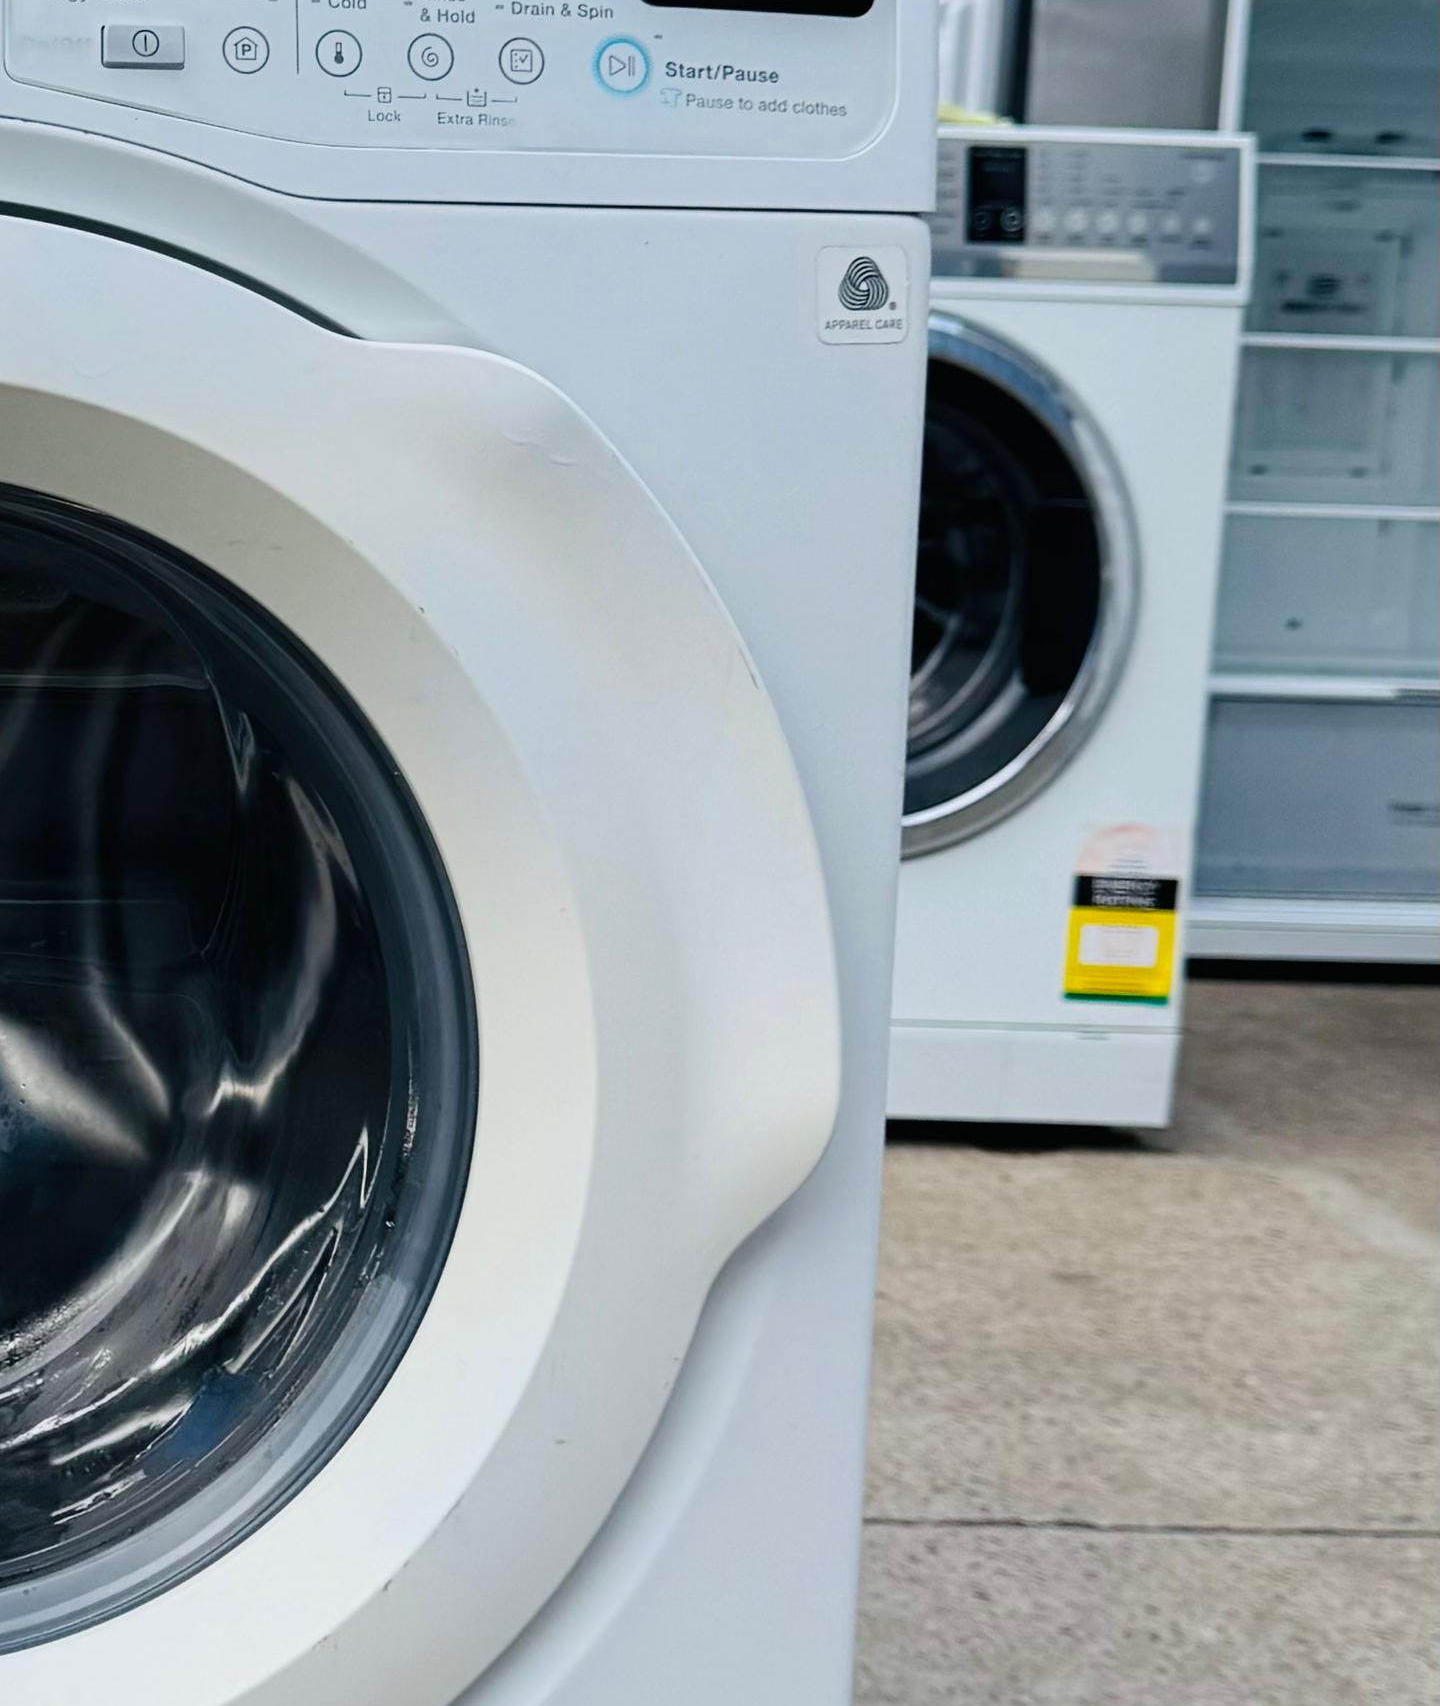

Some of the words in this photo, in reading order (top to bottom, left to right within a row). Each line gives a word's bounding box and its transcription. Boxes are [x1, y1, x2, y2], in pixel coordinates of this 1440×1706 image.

[420, 8, 431, 22] &
[437, 9, 475, 23] Hold
[511, 2, 555, 17] Drain
[561, 4, 572, 17] &
[577, 4, 614, 20] Spin
[665, 62, 779, 83] Start/Pause
[686, 94, 733, 110] Pause
[738, 96, 753, 111] to
[758, 97, 787, 113] add
[793, 99, 847, 117] clothes
[368, 109, 401, 123] Lock
[437, 112, 473, 125] Extra
[825, 319, 873, 330] APPAREL
[875, 318, 903, 330] CARE
